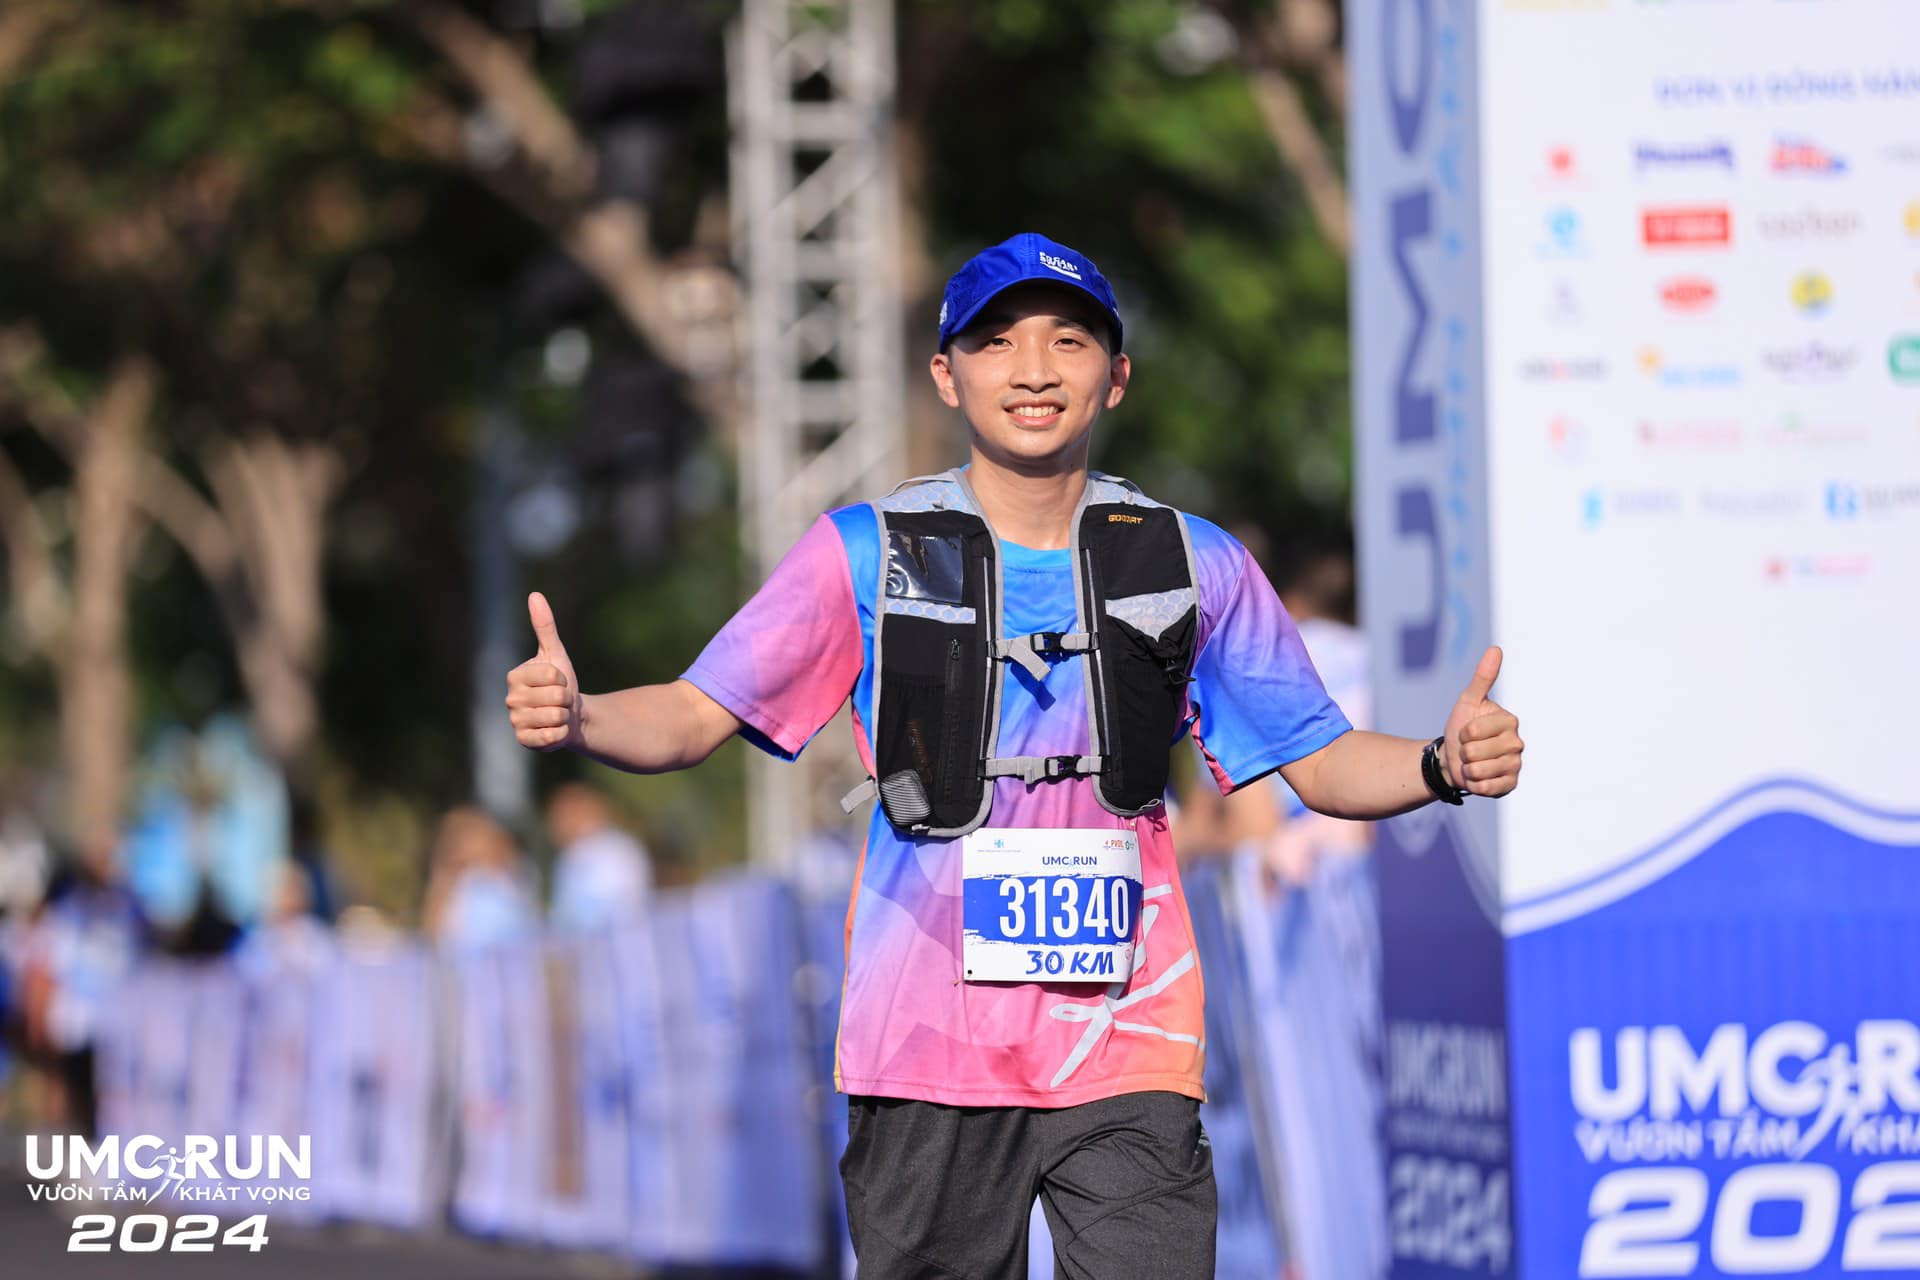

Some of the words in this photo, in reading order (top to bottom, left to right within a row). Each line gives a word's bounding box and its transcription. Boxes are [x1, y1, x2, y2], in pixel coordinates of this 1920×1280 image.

[999, 878, 1129, 938] 31340
[1025, 950, 1064, 975] 30
[1069, 951, 1114, 975] KM
[1569, 1021, 1828, 1122] UMC
